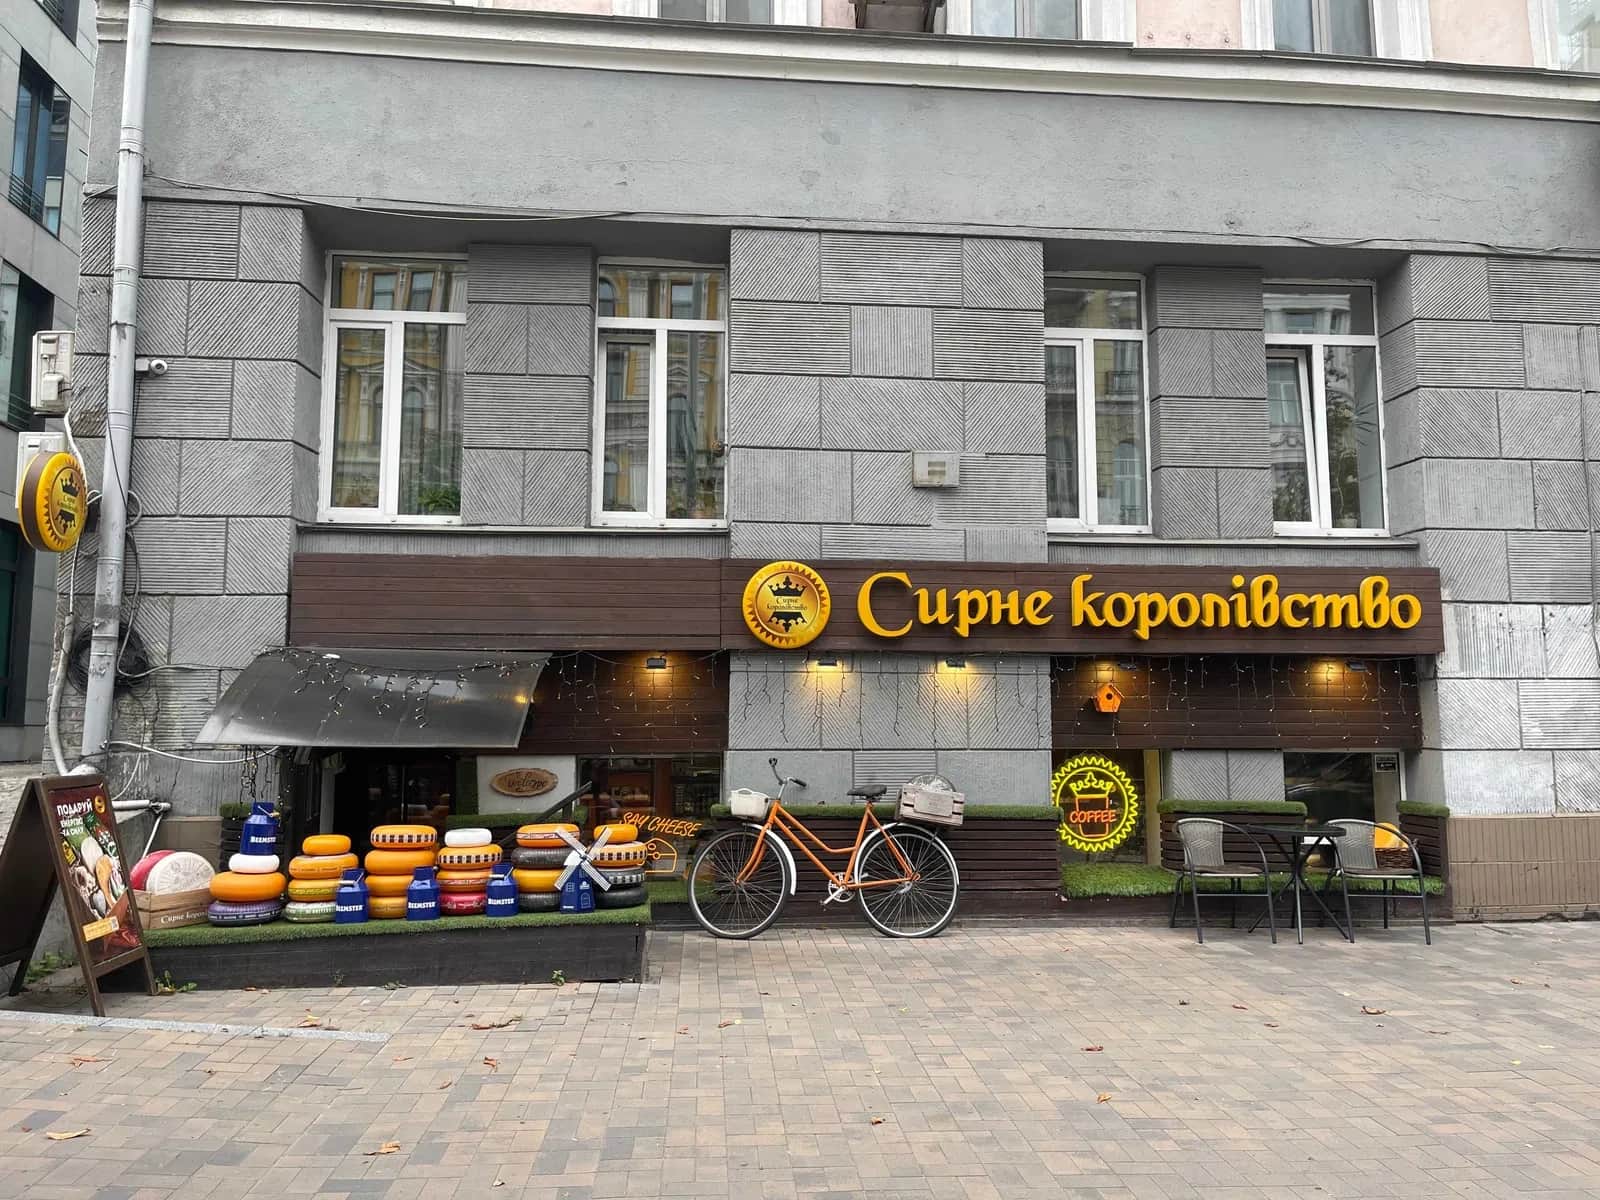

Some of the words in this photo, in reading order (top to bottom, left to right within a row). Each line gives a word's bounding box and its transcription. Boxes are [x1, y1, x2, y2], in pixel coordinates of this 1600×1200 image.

[857, 571, 1054, 638] Сирне
[1071, 574, 1422, 641] королівство
[57, 799, 92, 816] ПОДАРУЙ
[1069, 809, 1118, 823] COFFEE
[620, 812, 650, 828] SAY
[647, 816, 702, 837] CHEESE
